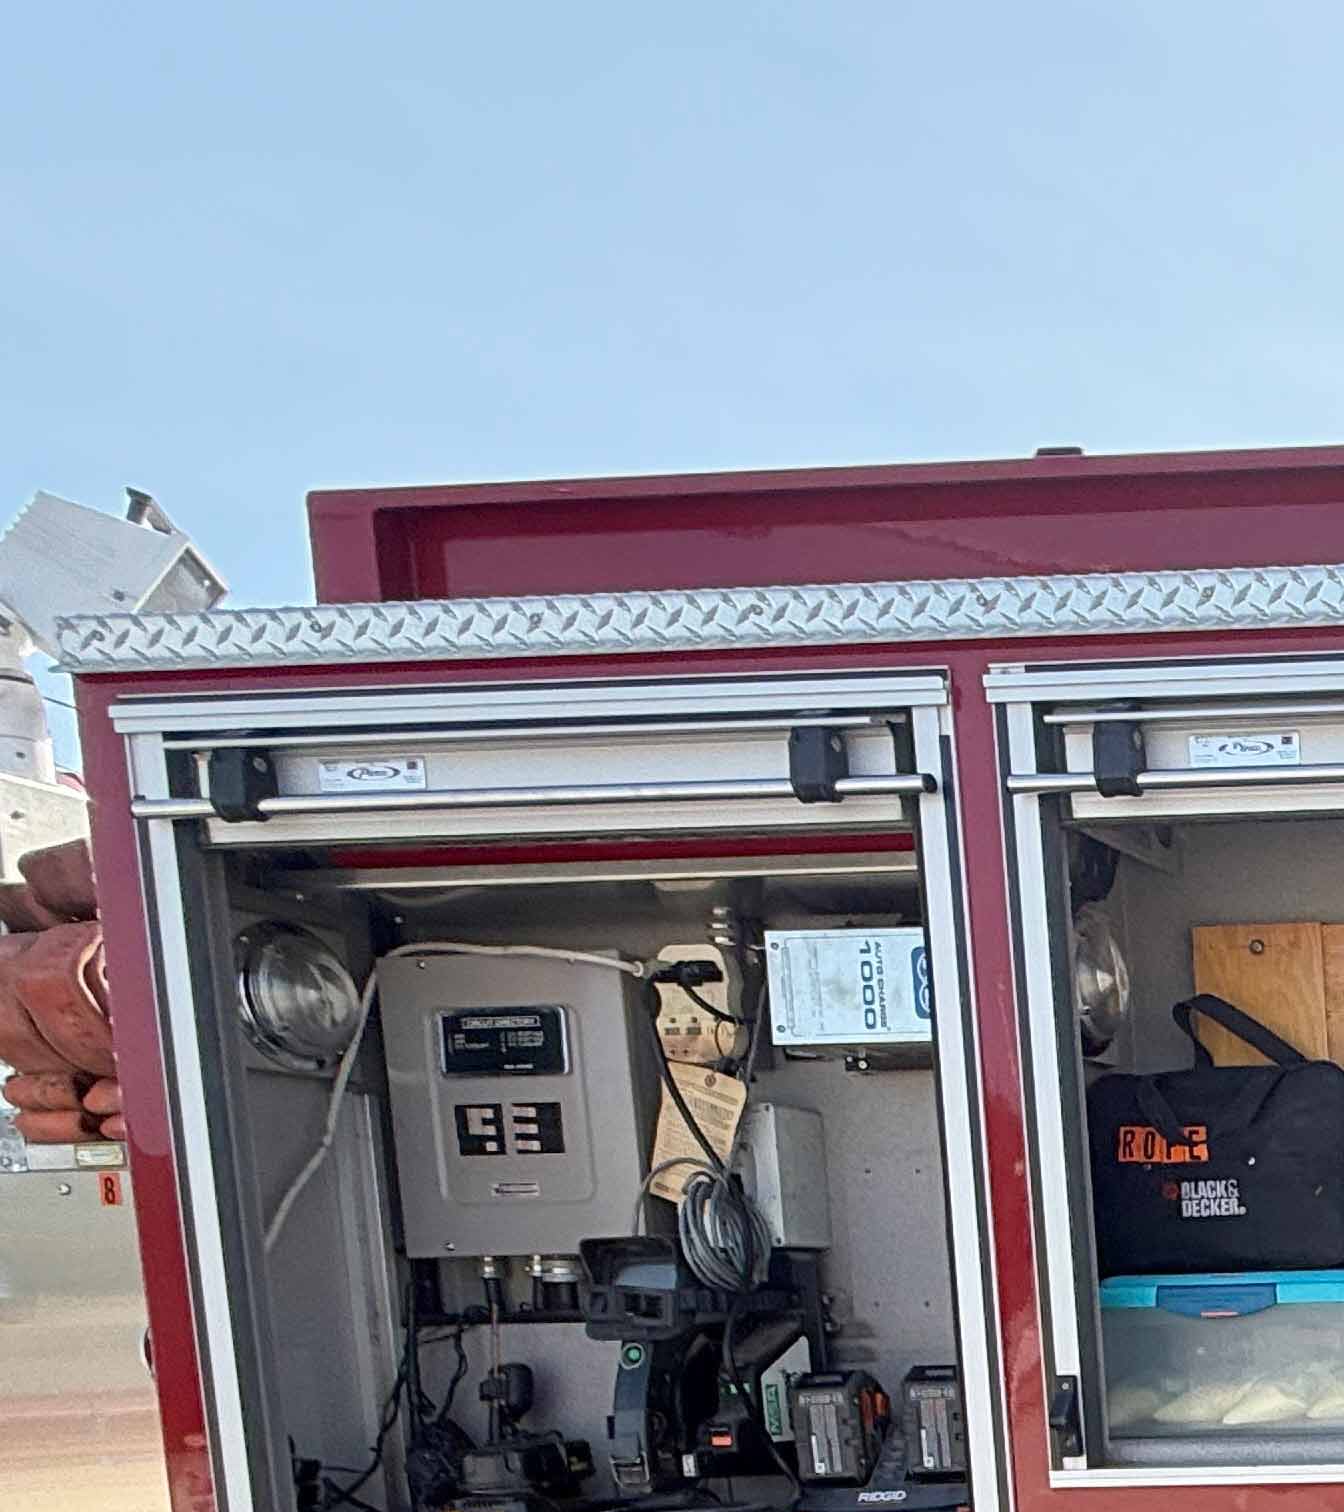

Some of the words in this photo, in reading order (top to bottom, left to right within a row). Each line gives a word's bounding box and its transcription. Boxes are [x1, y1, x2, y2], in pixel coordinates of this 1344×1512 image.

[874, 941, 884, 975] AUTO
[859, 939, 876, 1030] 1000
[104, 1176, 116, 1204] 8
[858, 1489, 907, 1502] RIDGID
